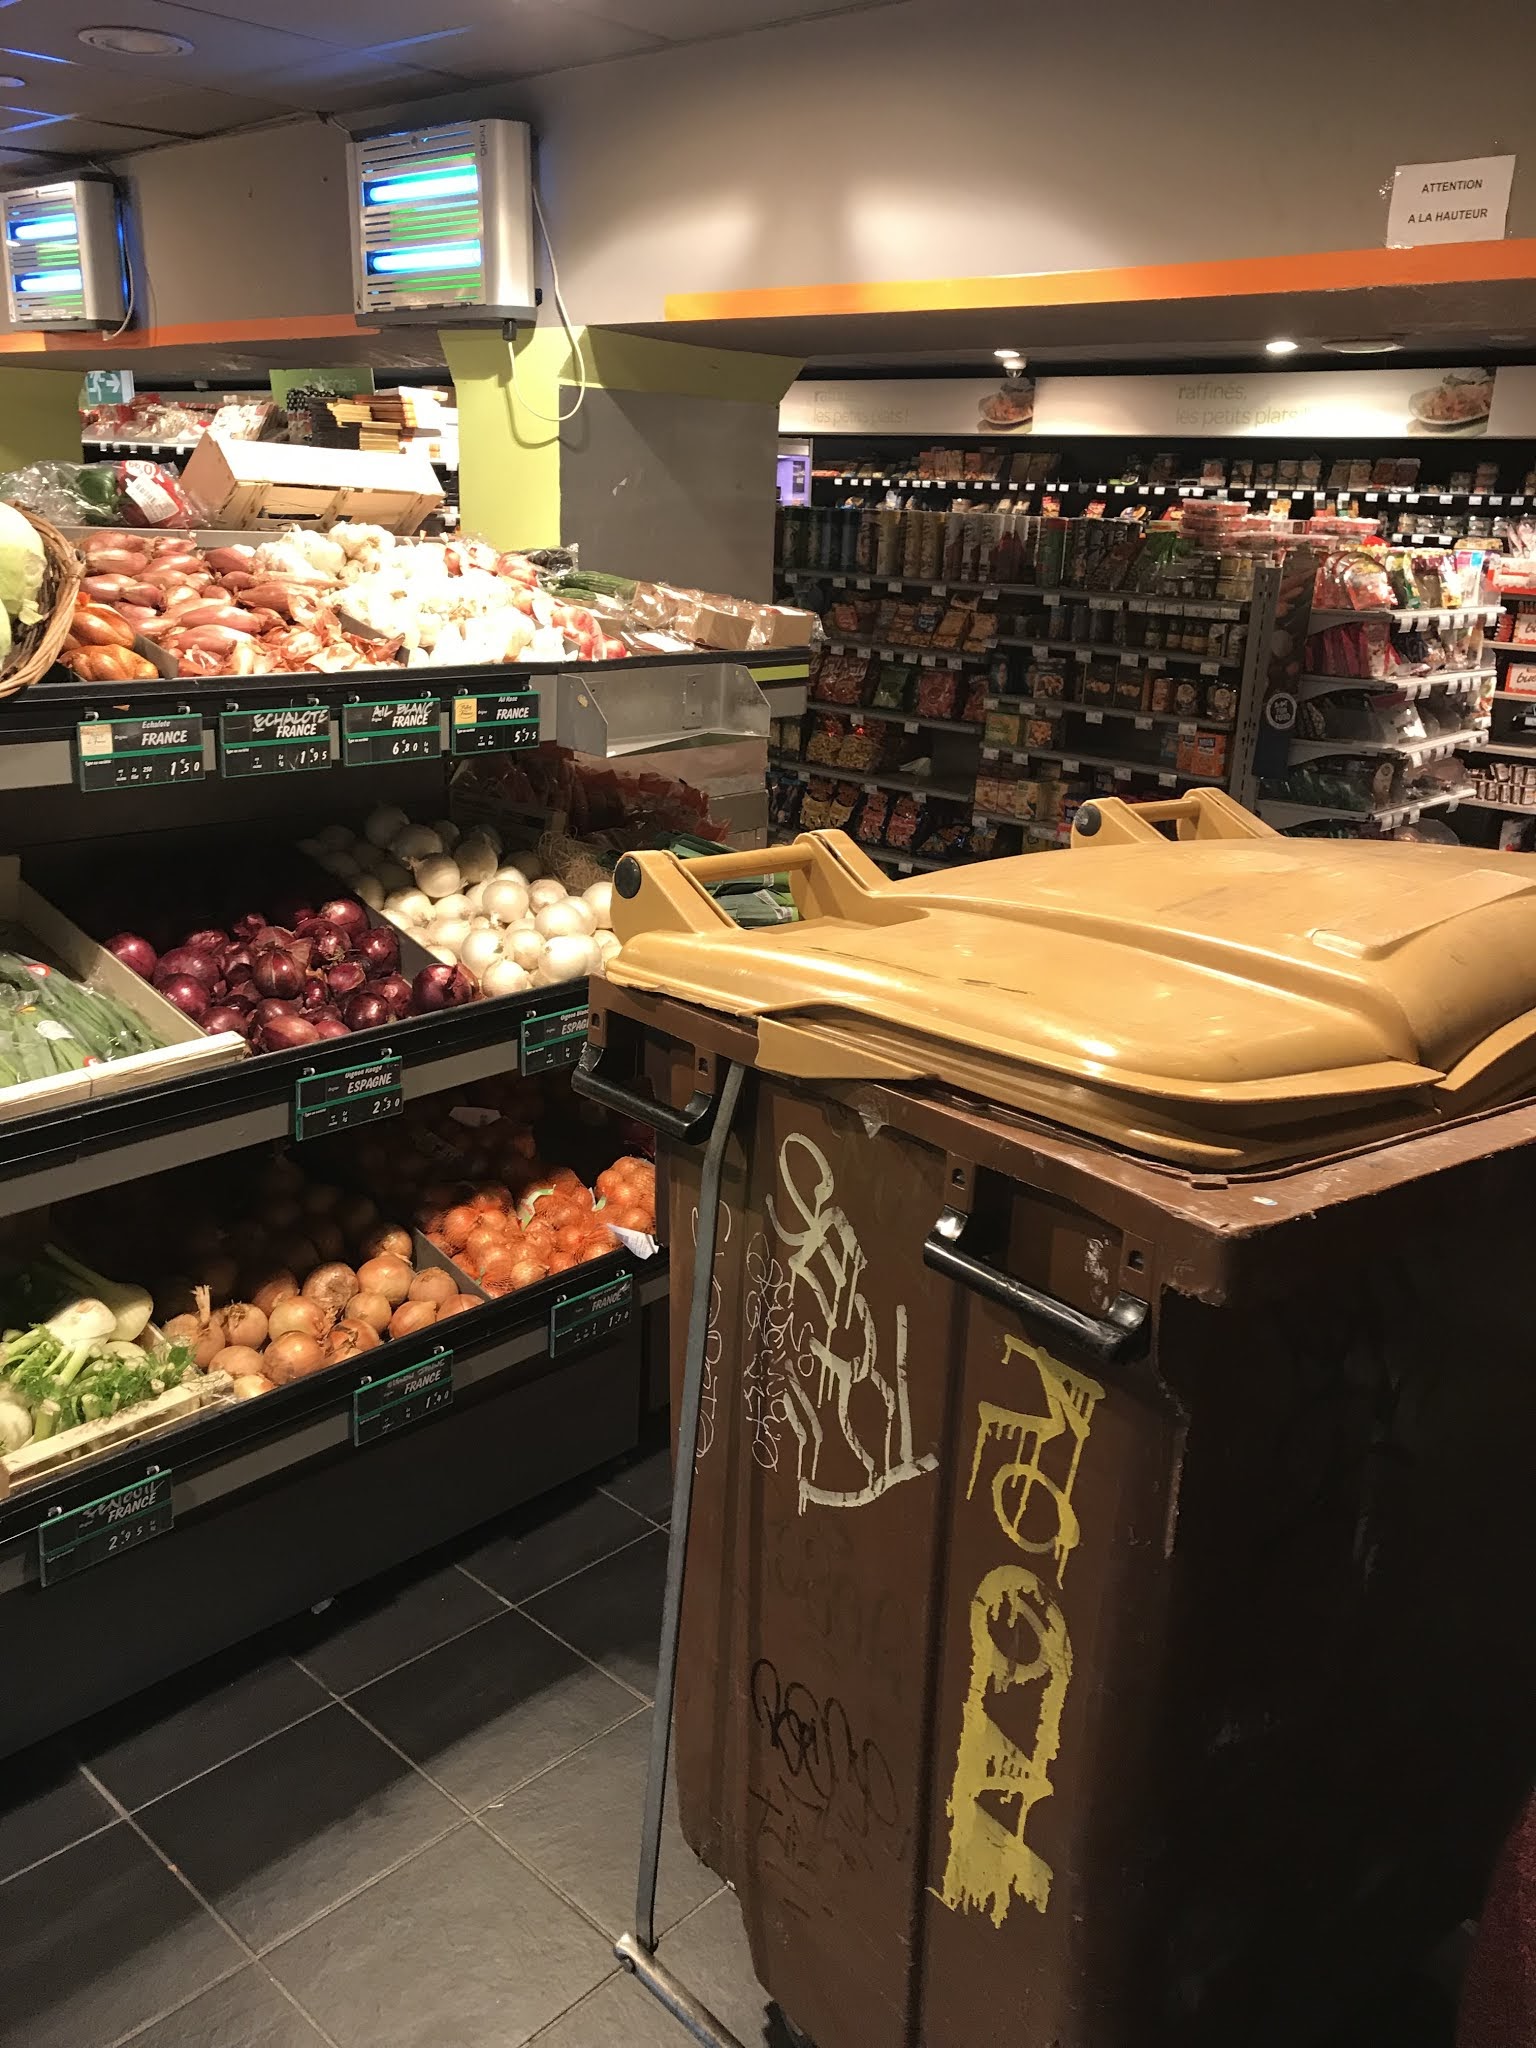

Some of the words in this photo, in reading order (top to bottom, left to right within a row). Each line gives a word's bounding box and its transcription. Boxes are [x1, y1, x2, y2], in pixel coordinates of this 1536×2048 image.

[1421, 179, 1484, 194] ATTENTION
[1407, 214, 1416, 224] A
[1418, 213, 1433, 223] LA
[1435, 208, 1489, 222] HAUTEUR
[253, 709, 329, 728] ECHALOTE
[391, 713, 430, 728] FRANCE
[496, 706, 530, 721] FRANCE
[142, 720, 171, 729] Echalote
[275, 723, 318, 739] FRANCE
[141, 730, 188, 746] FRANCE
[347, 1072, 393, 1094] ESPAGNE
[404, 1370, 442, 1395] FRANCE
[107, 1491, 157, 1523] FRANCE
